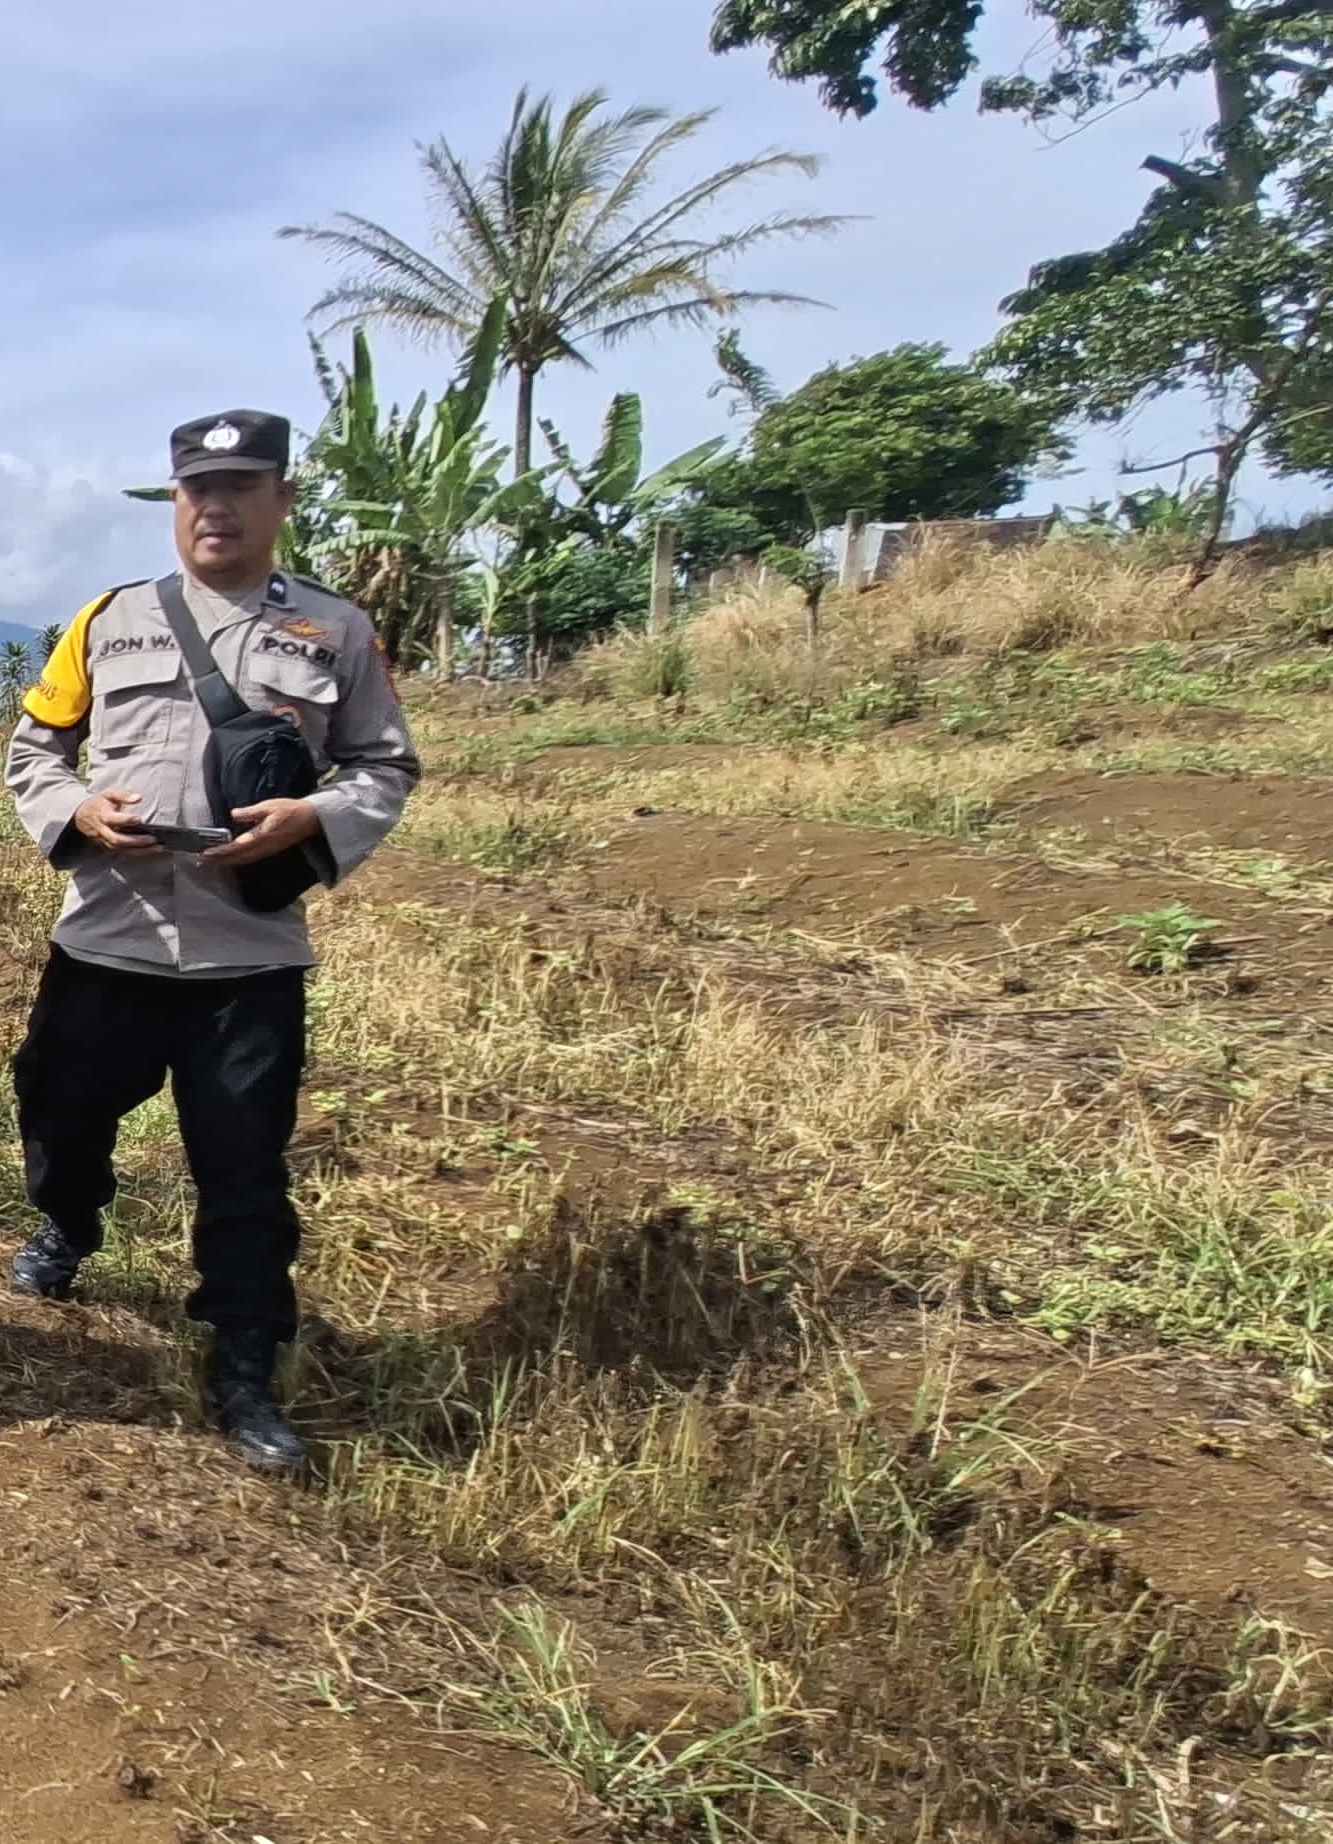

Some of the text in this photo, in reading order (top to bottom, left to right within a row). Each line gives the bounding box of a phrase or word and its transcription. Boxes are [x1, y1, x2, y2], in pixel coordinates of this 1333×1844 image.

[99, 634, 175, 656] JON W.
[261, 636, 336, 667] POLRI
